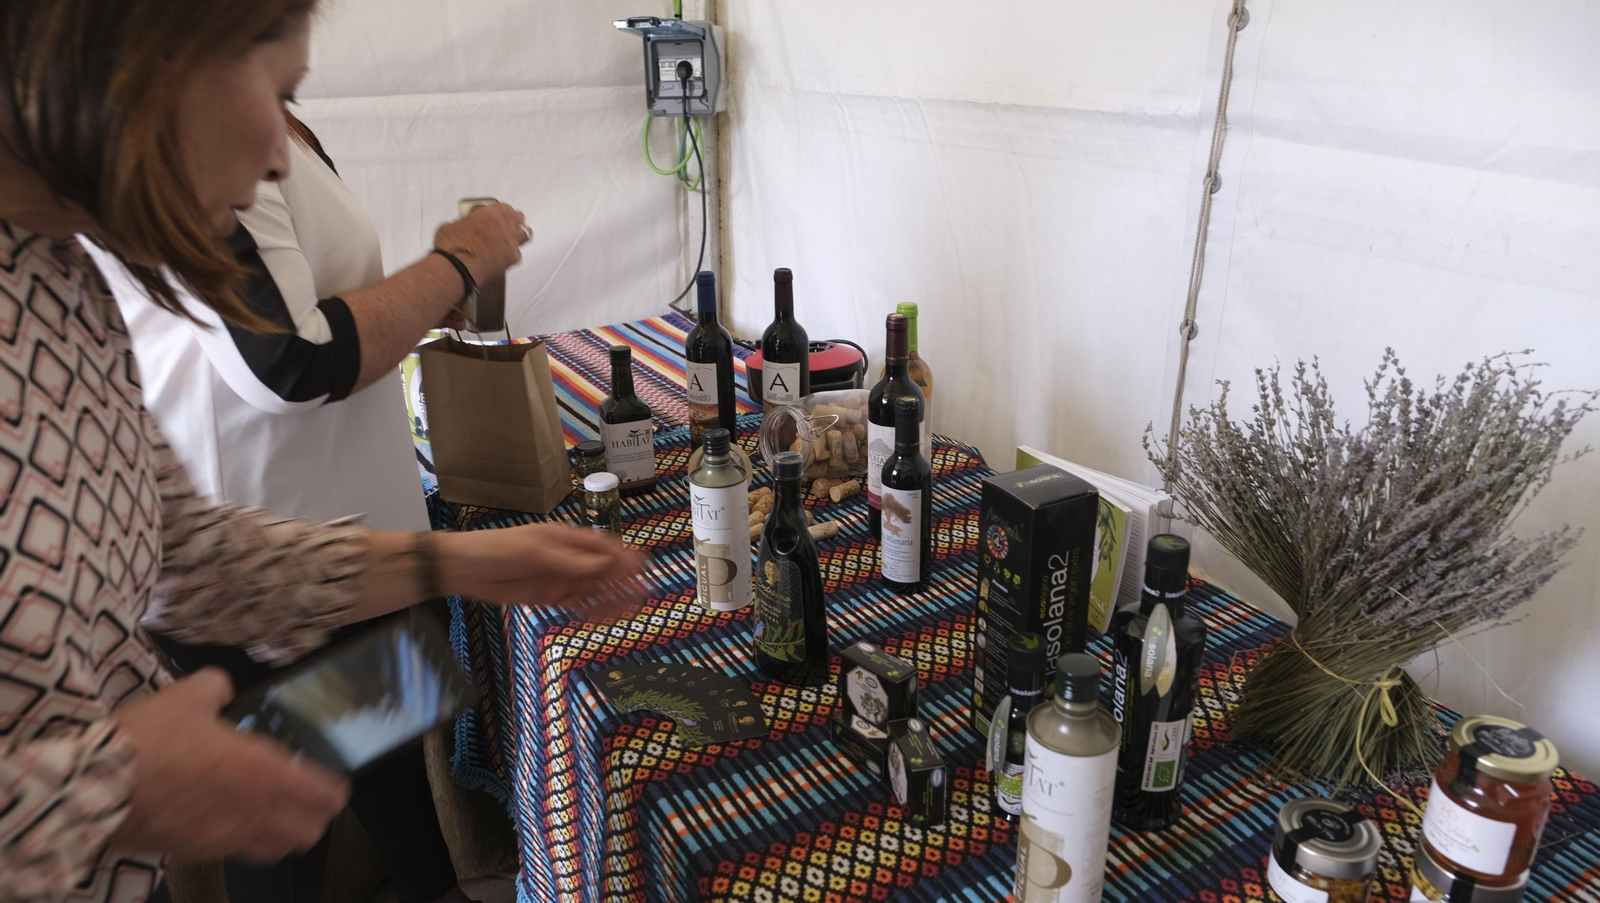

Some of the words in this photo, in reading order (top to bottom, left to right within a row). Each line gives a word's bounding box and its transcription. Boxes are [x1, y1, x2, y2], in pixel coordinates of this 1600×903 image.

[689, 372, 705, 392] A
[769, 372, 789, 393] A
[611, 434, 651, 449] HABITAT
[700, 563, 709, 603] PICUAL
[1112, 648, 1128, 723] olana2
[1016, 845, 1028, 901] PICUAL
